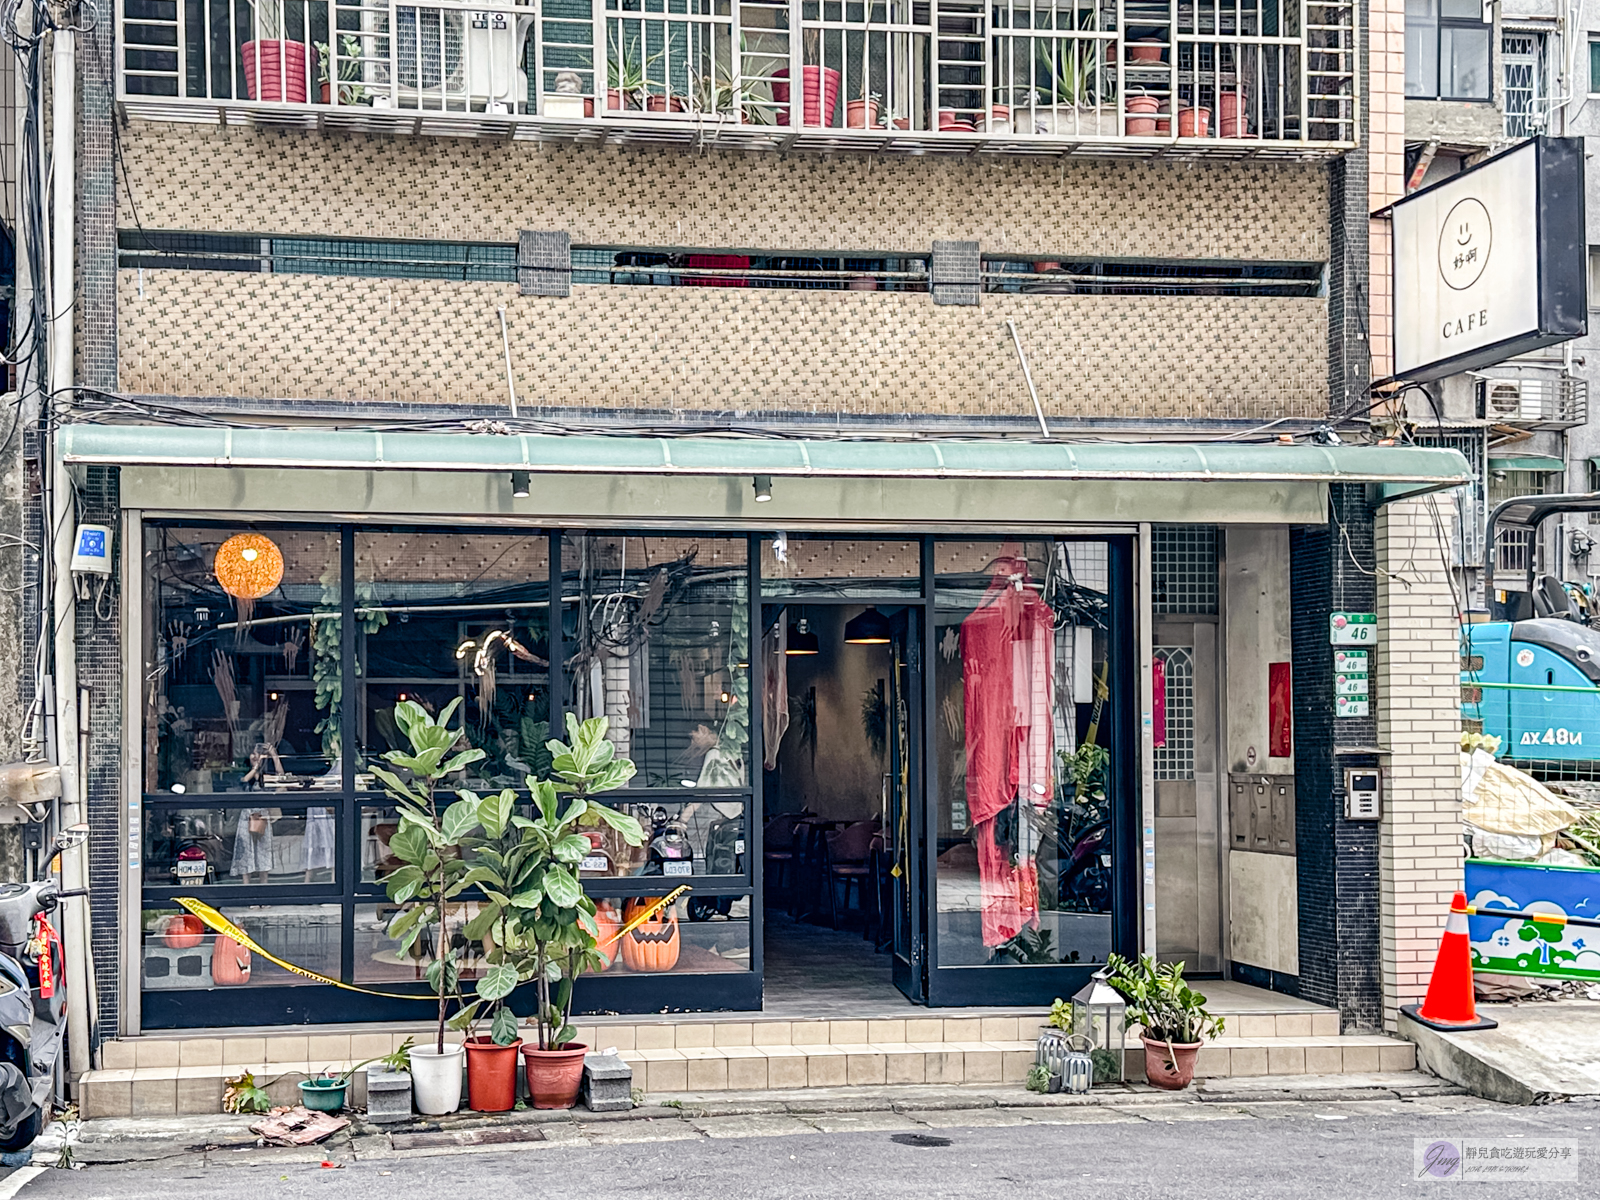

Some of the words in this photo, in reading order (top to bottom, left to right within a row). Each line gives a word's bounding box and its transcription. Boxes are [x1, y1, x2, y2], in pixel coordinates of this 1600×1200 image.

[475, 13, 504, 21] TEO
[1443, 309, 1488, 339] CAFE
[1351, 627, 1368, 640] 46
[1346, 661, 1357, 670] 46
[1347, 683, 1358, 692] 46
[1347, 705, 1358, 714] 46
